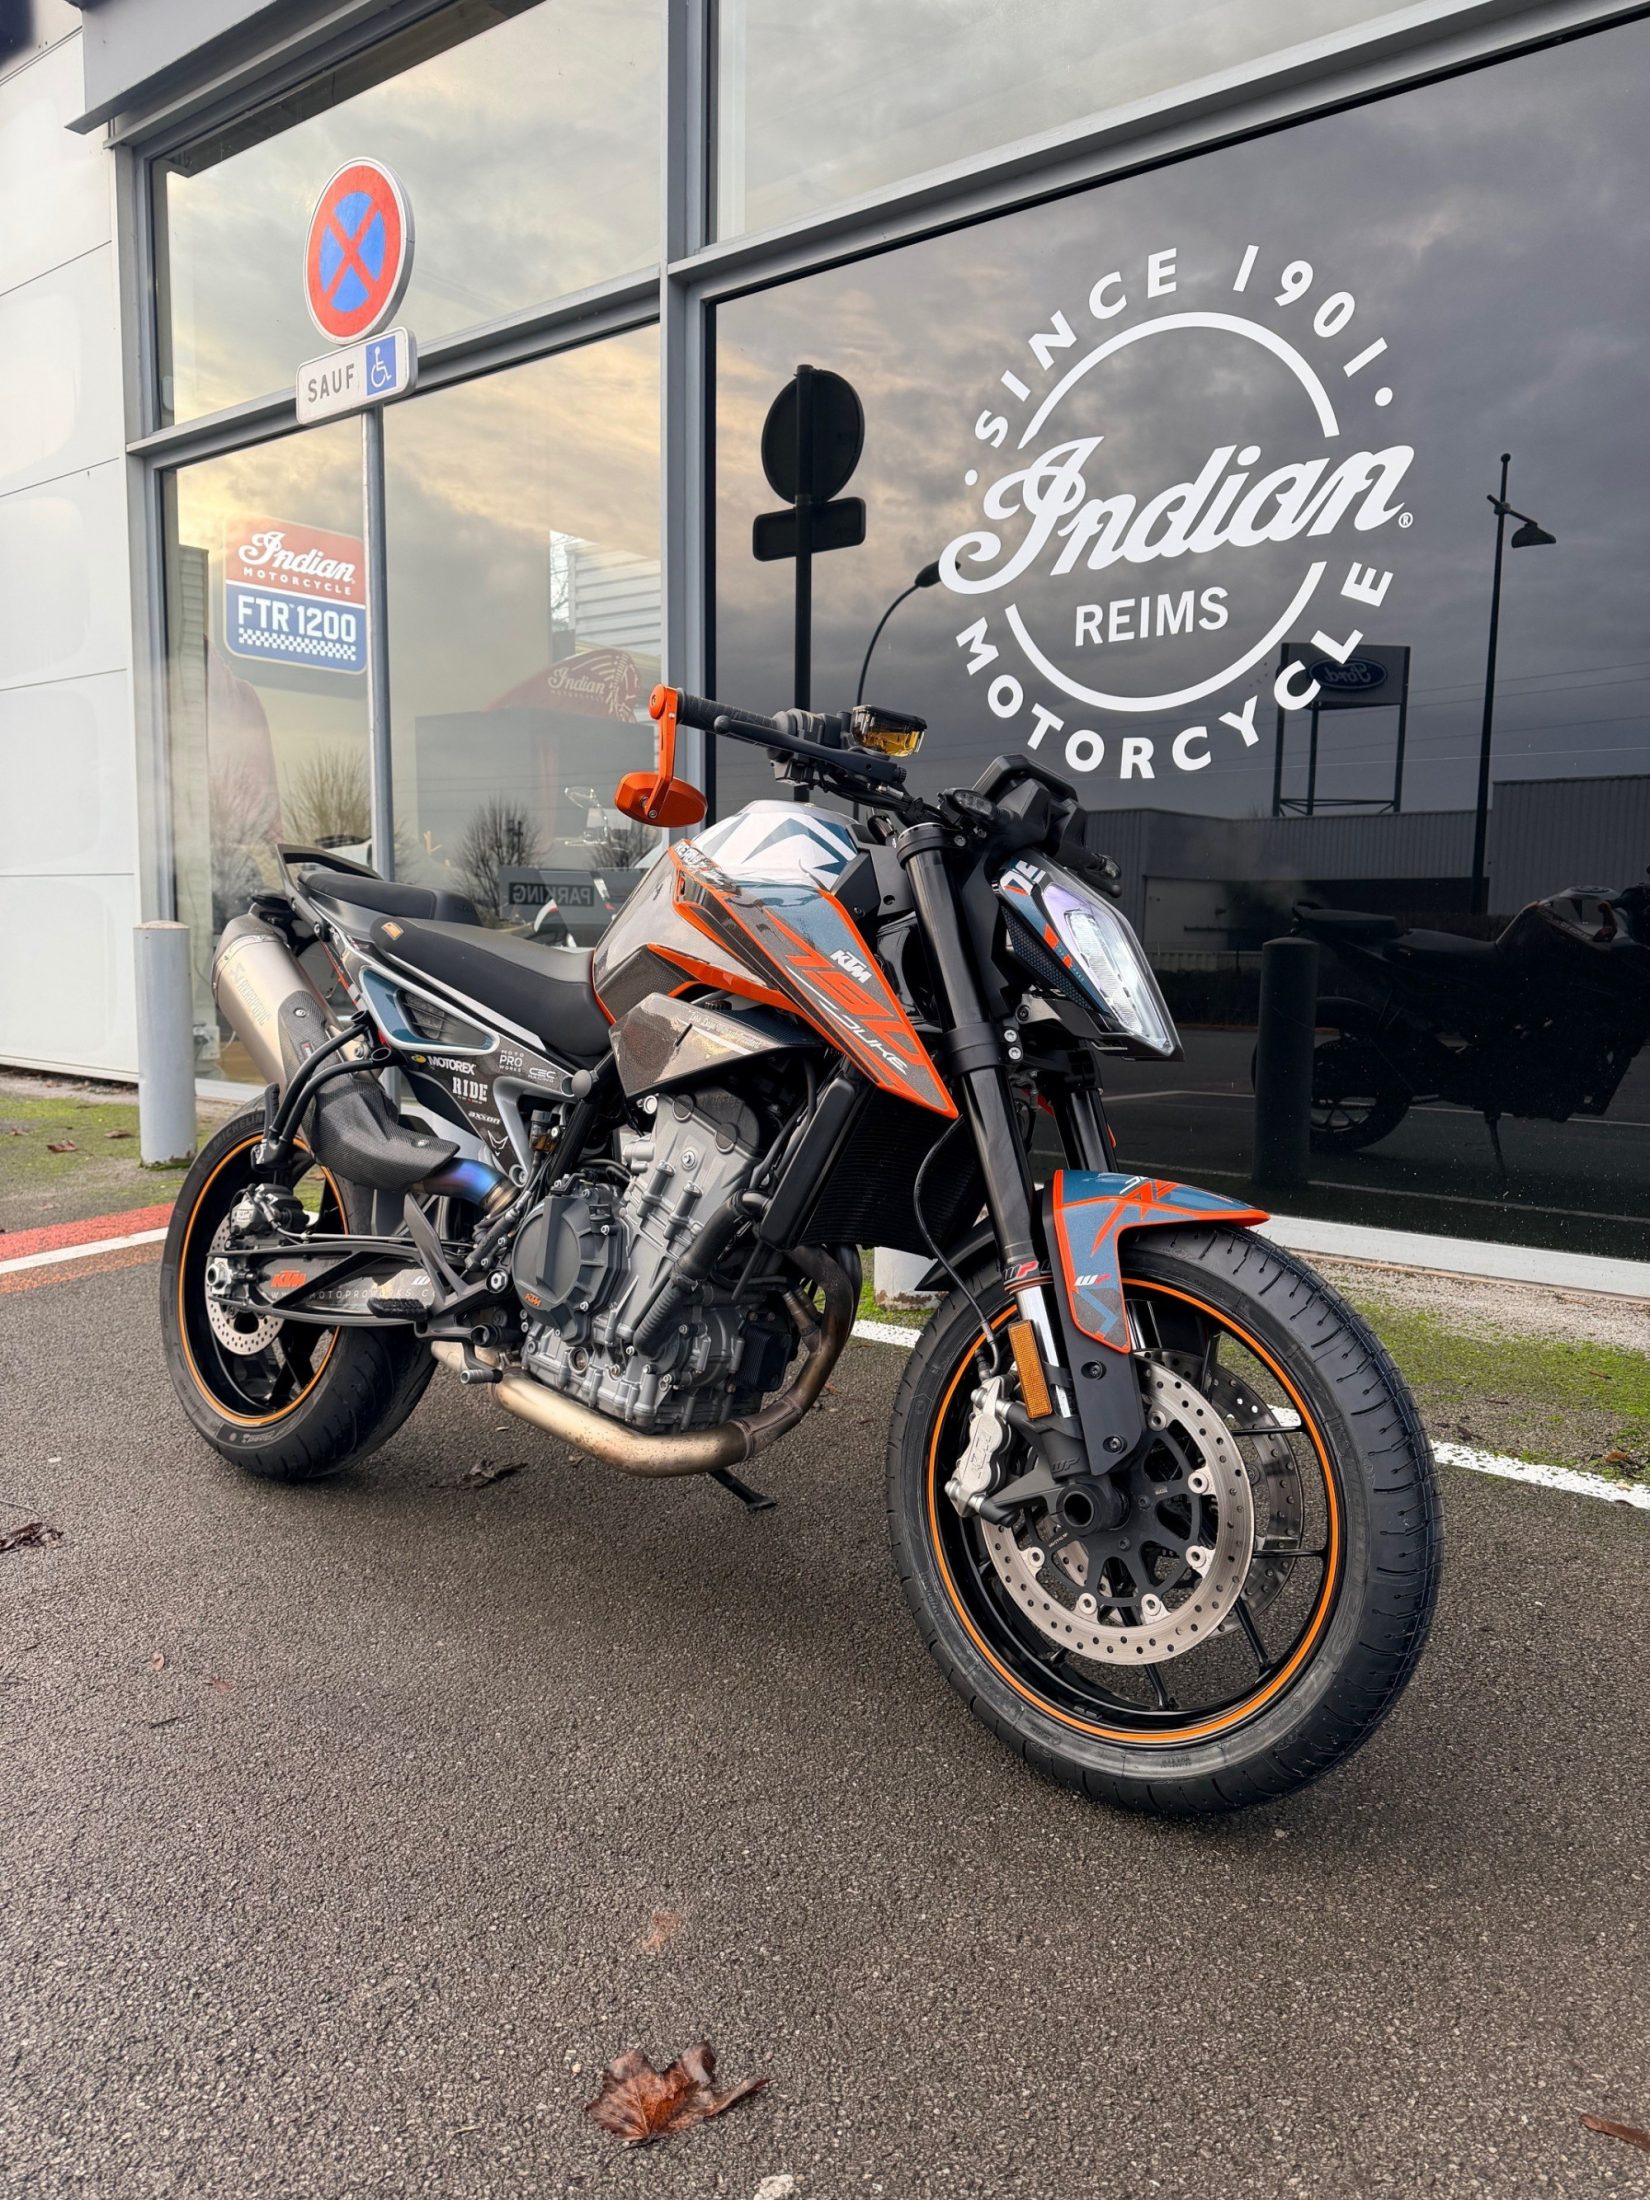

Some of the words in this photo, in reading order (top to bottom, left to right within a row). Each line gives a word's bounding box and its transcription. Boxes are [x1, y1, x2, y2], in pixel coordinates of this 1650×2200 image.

[975, 247, 1177, 448] SINCE
[307, 362, 356, 403] SAUF
[938, 435, 1415, 596] Indian
[238, 531, 356, 582] Indian
[243, 567, 352, 596] MOTORCYCLE
[297, 605, 357, 643] 1200
[1074, 586, 1230, 647] REIMS
[547, 666, 606, 695] Indian
[955, 560, 1394, 780] MOTORCYCLE
[830, 949, 873, 984] KTM
[812, 995, 909, 1076] DUKE
[427, 1055, 476, 1075] MOTOREX
[499, 1054, 523, 1068] PRO
[500, 1049, 525, 1058] MOTO
[498, 1065, 522, 1073] WORKS
[452, 1076, 489, 1102] RIDE
[270, 1270, 307, 1288] KTM
[1074, 1273, 1111, 1287] WP
[524, 1292, 543, 1307] KTM
[1051, 1457, 1080, 1473] WP
